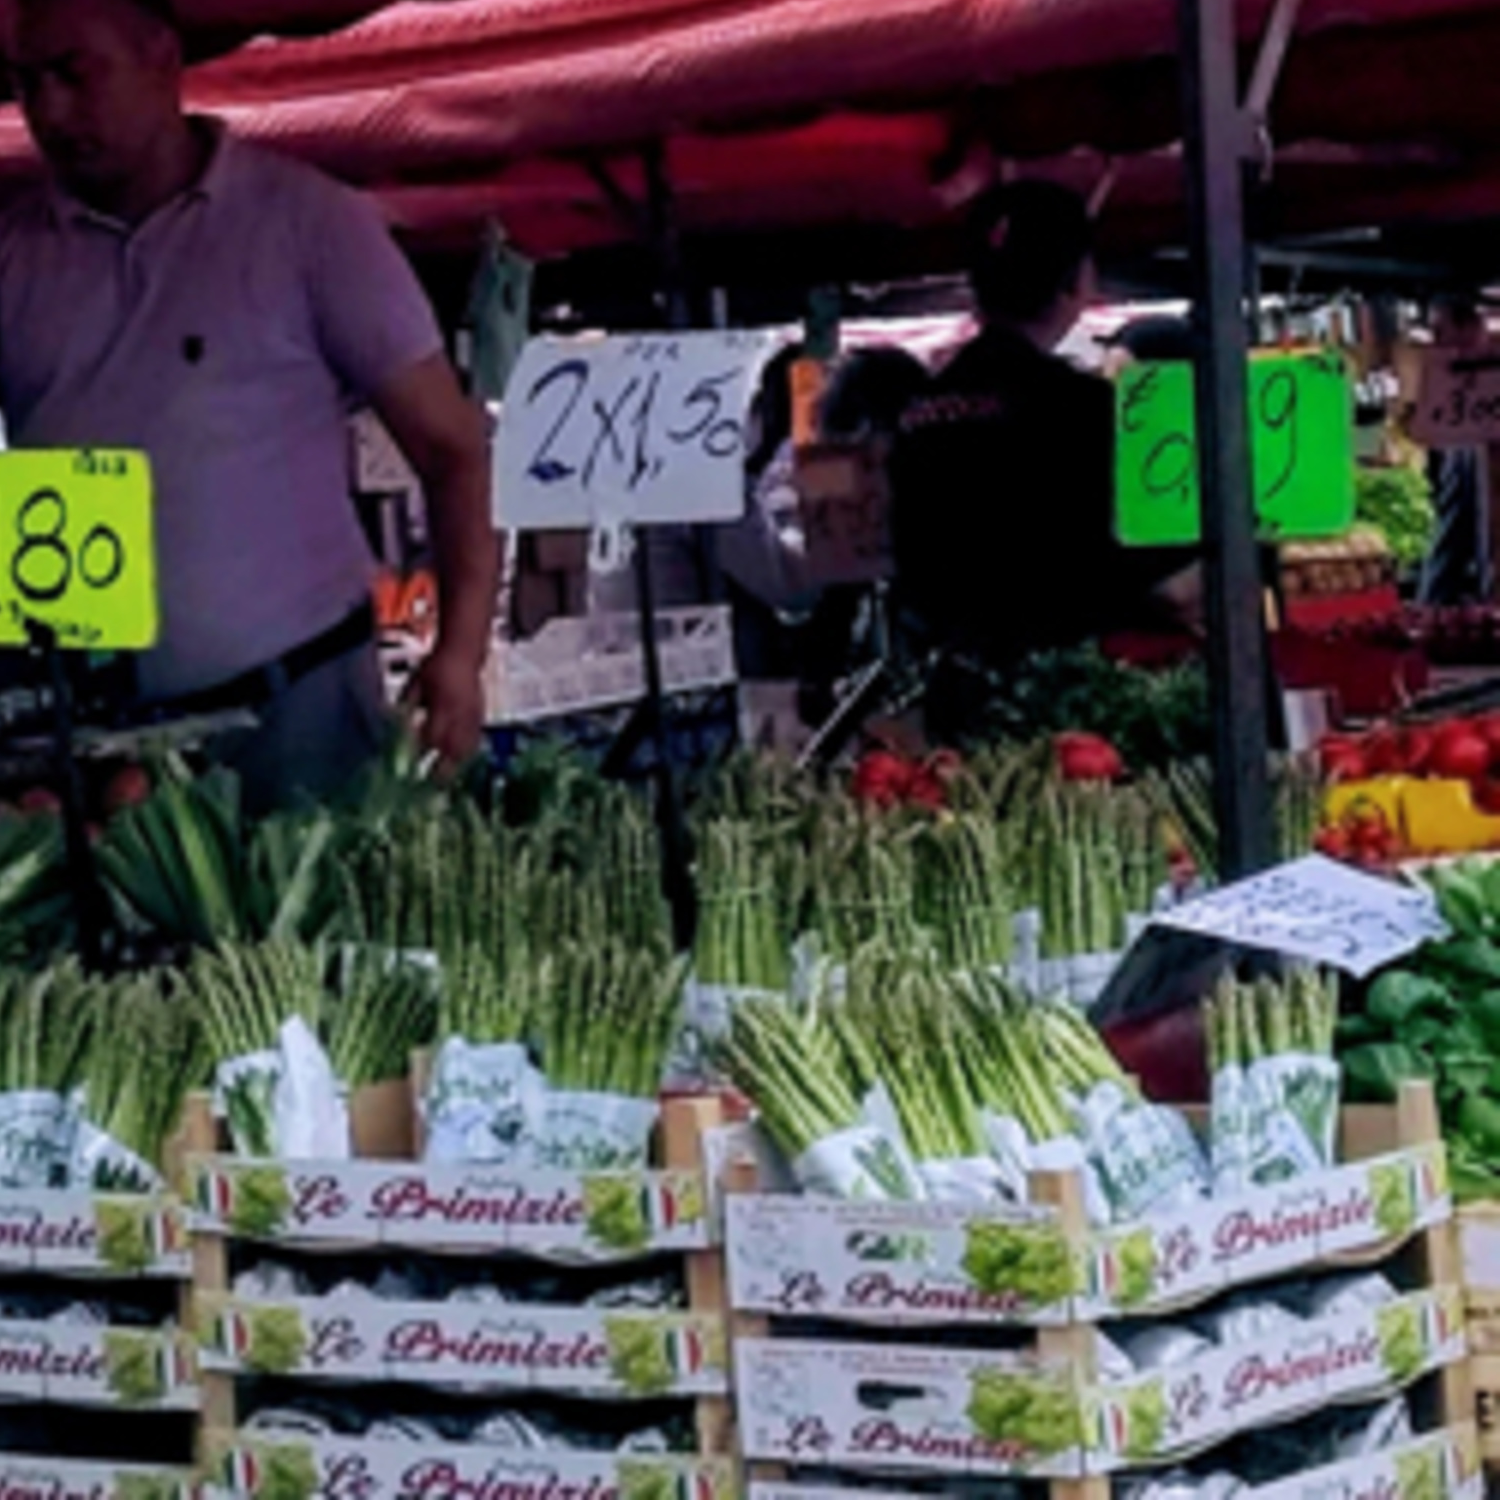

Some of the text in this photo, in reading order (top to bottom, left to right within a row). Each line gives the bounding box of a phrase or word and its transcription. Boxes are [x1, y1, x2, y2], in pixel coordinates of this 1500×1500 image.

[366, 1176, 583, 1226] Primizie
[1212, 1189, 1371, 1260] Primizie
[383, 1320, 608, 1369] Primizie
[1222, 1333, 1380, 1410] Primizie
